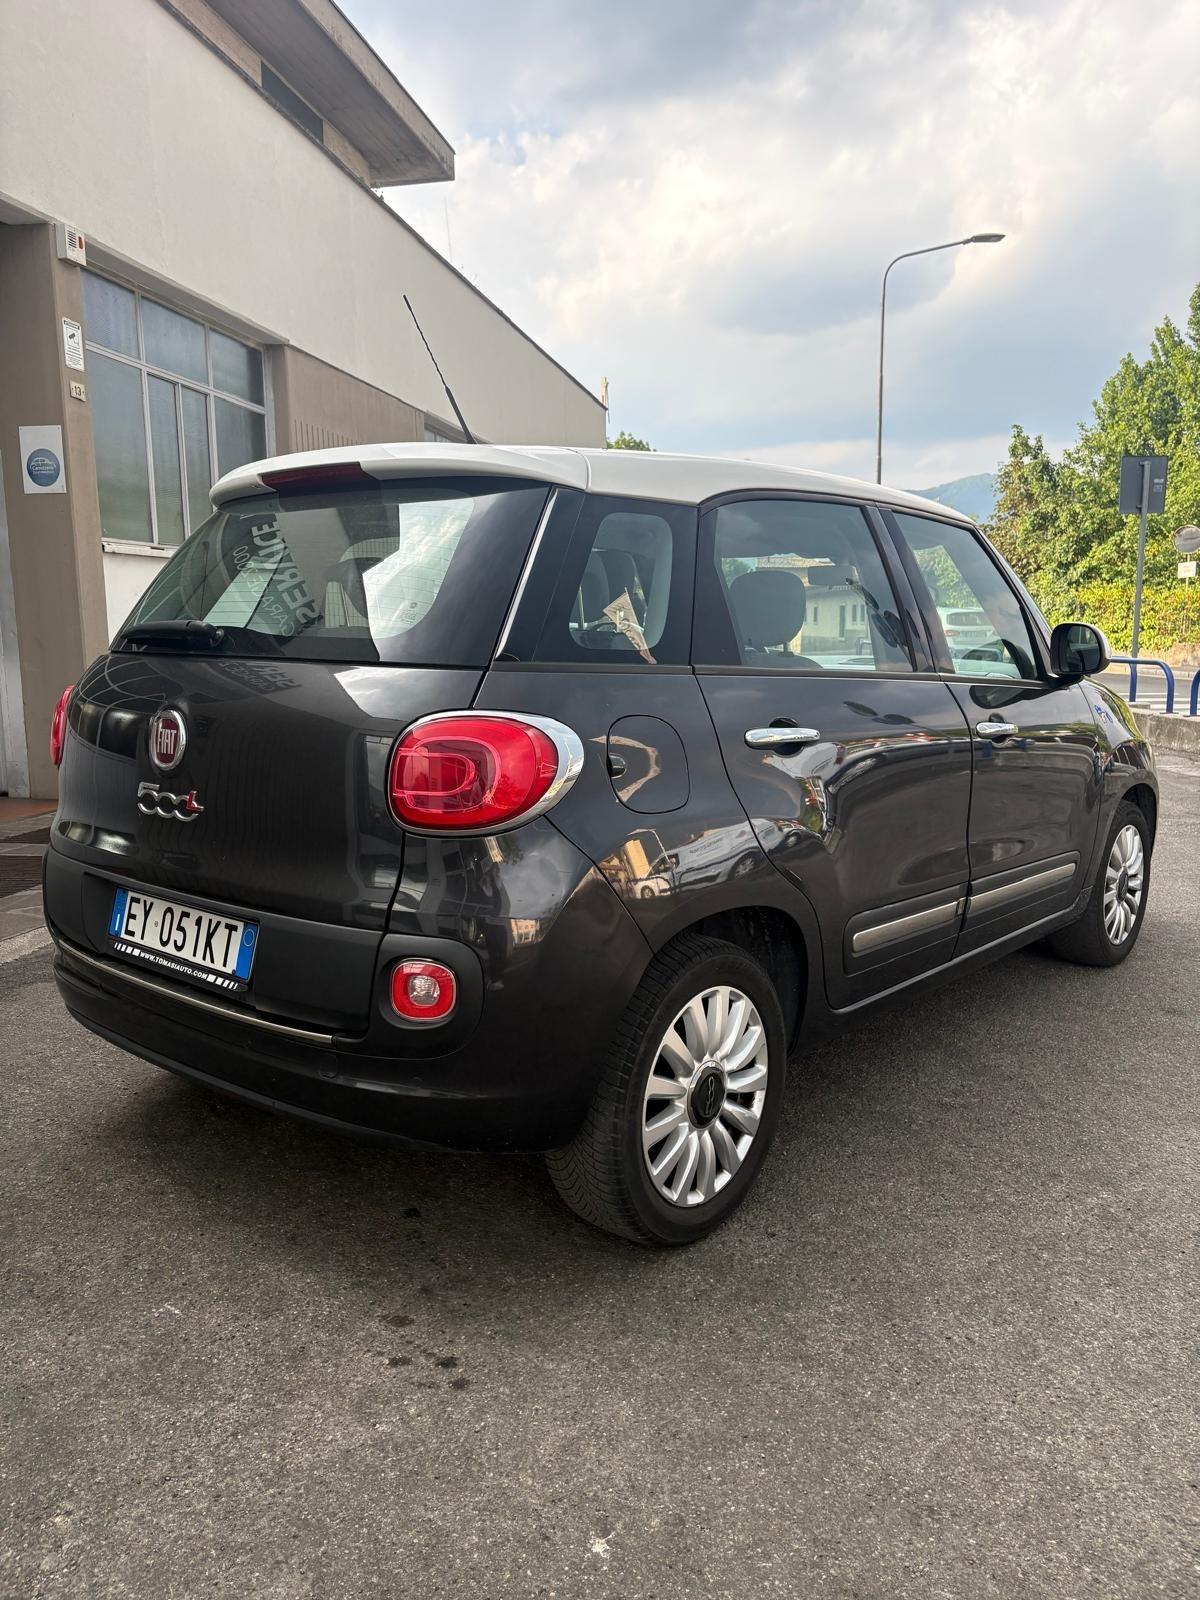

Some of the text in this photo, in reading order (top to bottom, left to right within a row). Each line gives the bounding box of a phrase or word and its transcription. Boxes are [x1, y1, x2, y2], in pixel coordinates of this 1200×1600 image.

[157, 728, 177, 755] FIAT
[124, 896, 238, 968] EY 051KT
[139, 951, 208, 980] WWW.TOMASIAUTO.COM
